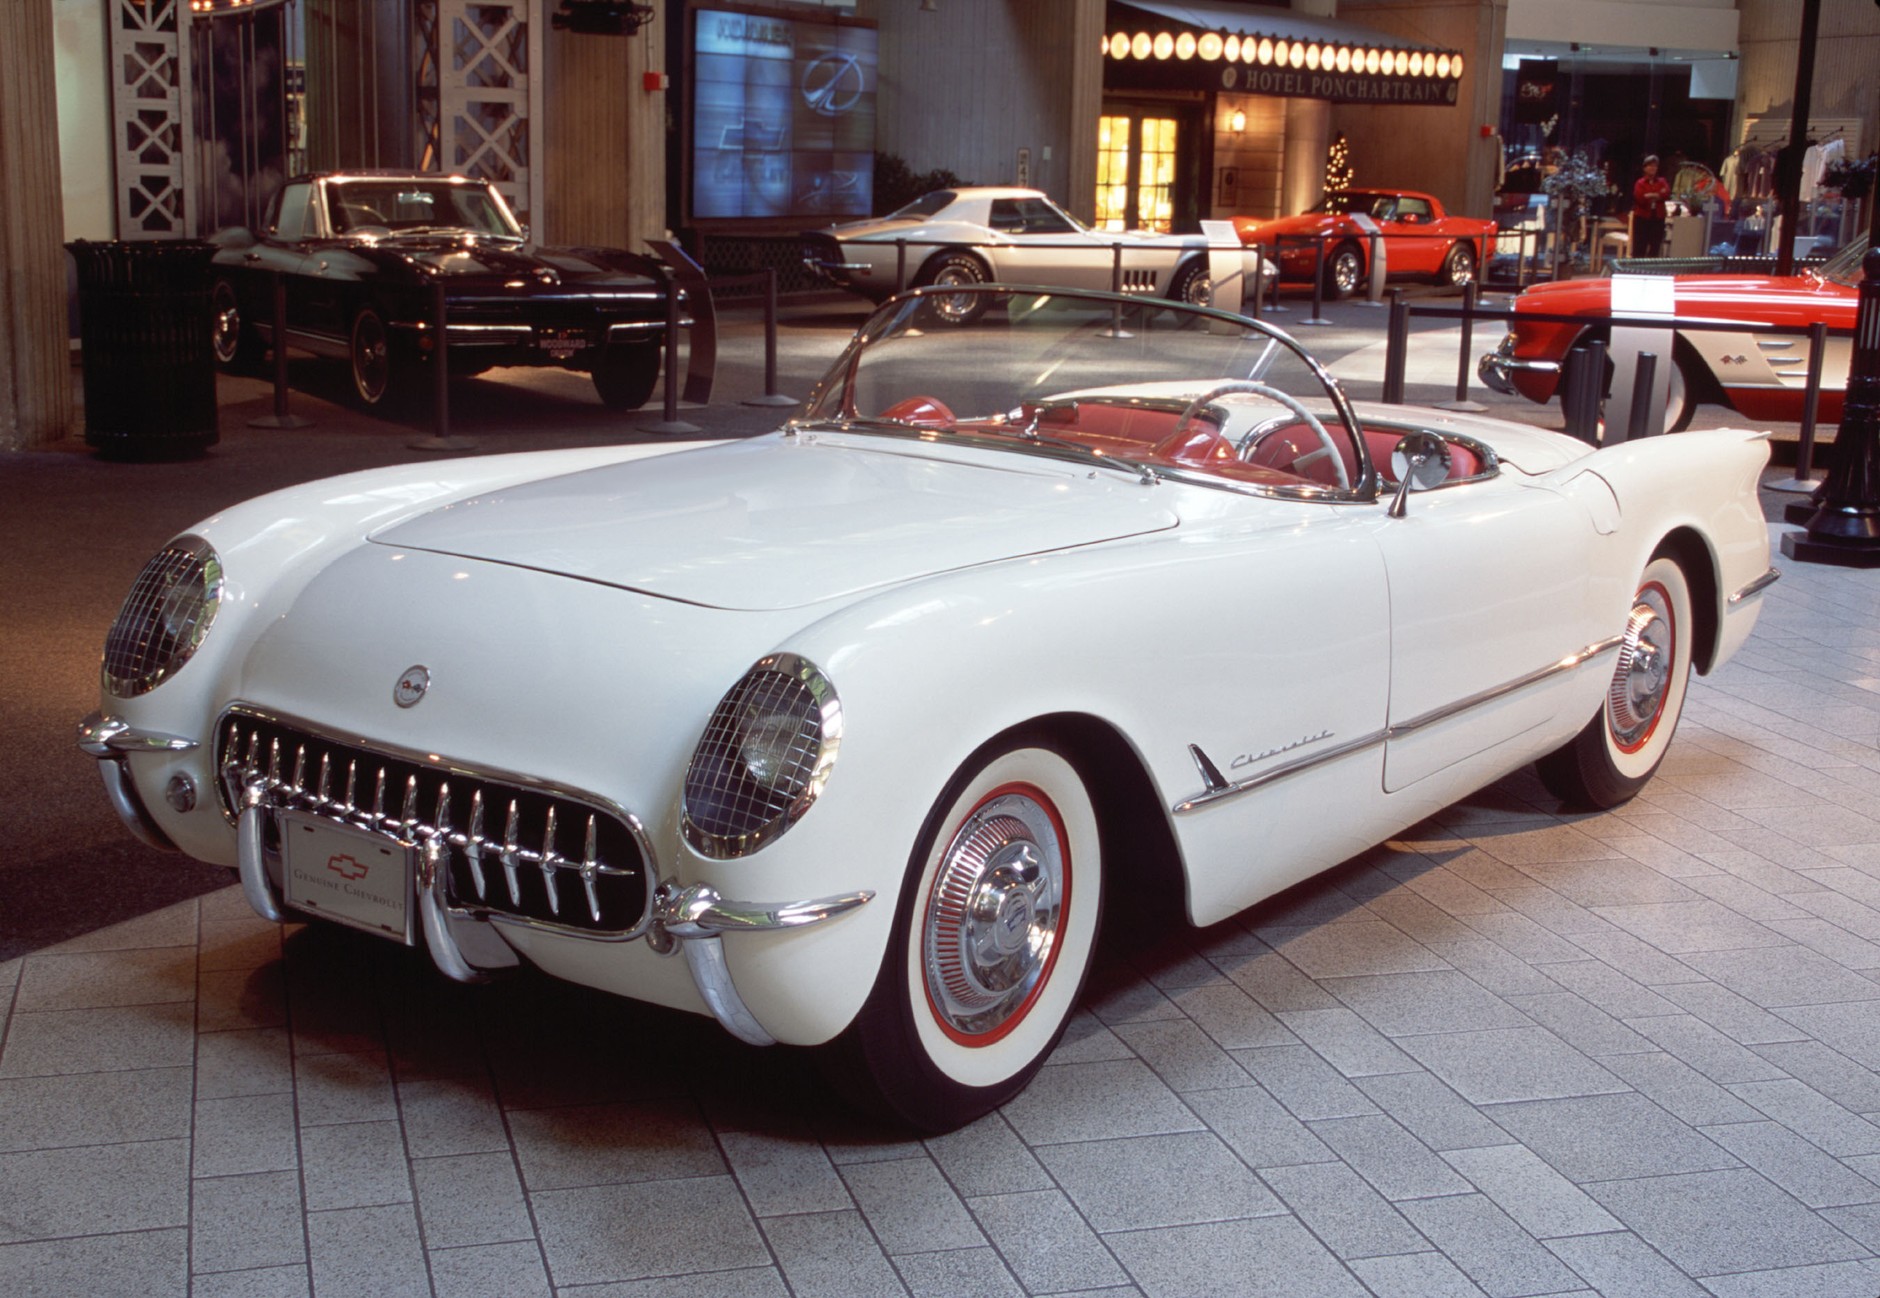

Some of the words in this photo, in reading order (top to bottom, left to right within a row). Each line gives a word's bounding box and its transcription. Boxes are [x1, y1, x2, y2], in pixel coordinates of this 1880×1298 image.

[1246, 70, 1305, 93] HOTEL
[1311, 76, 1442, 101] PONCHARTRAIN
[293, 868, 340, 892] GENUINE
